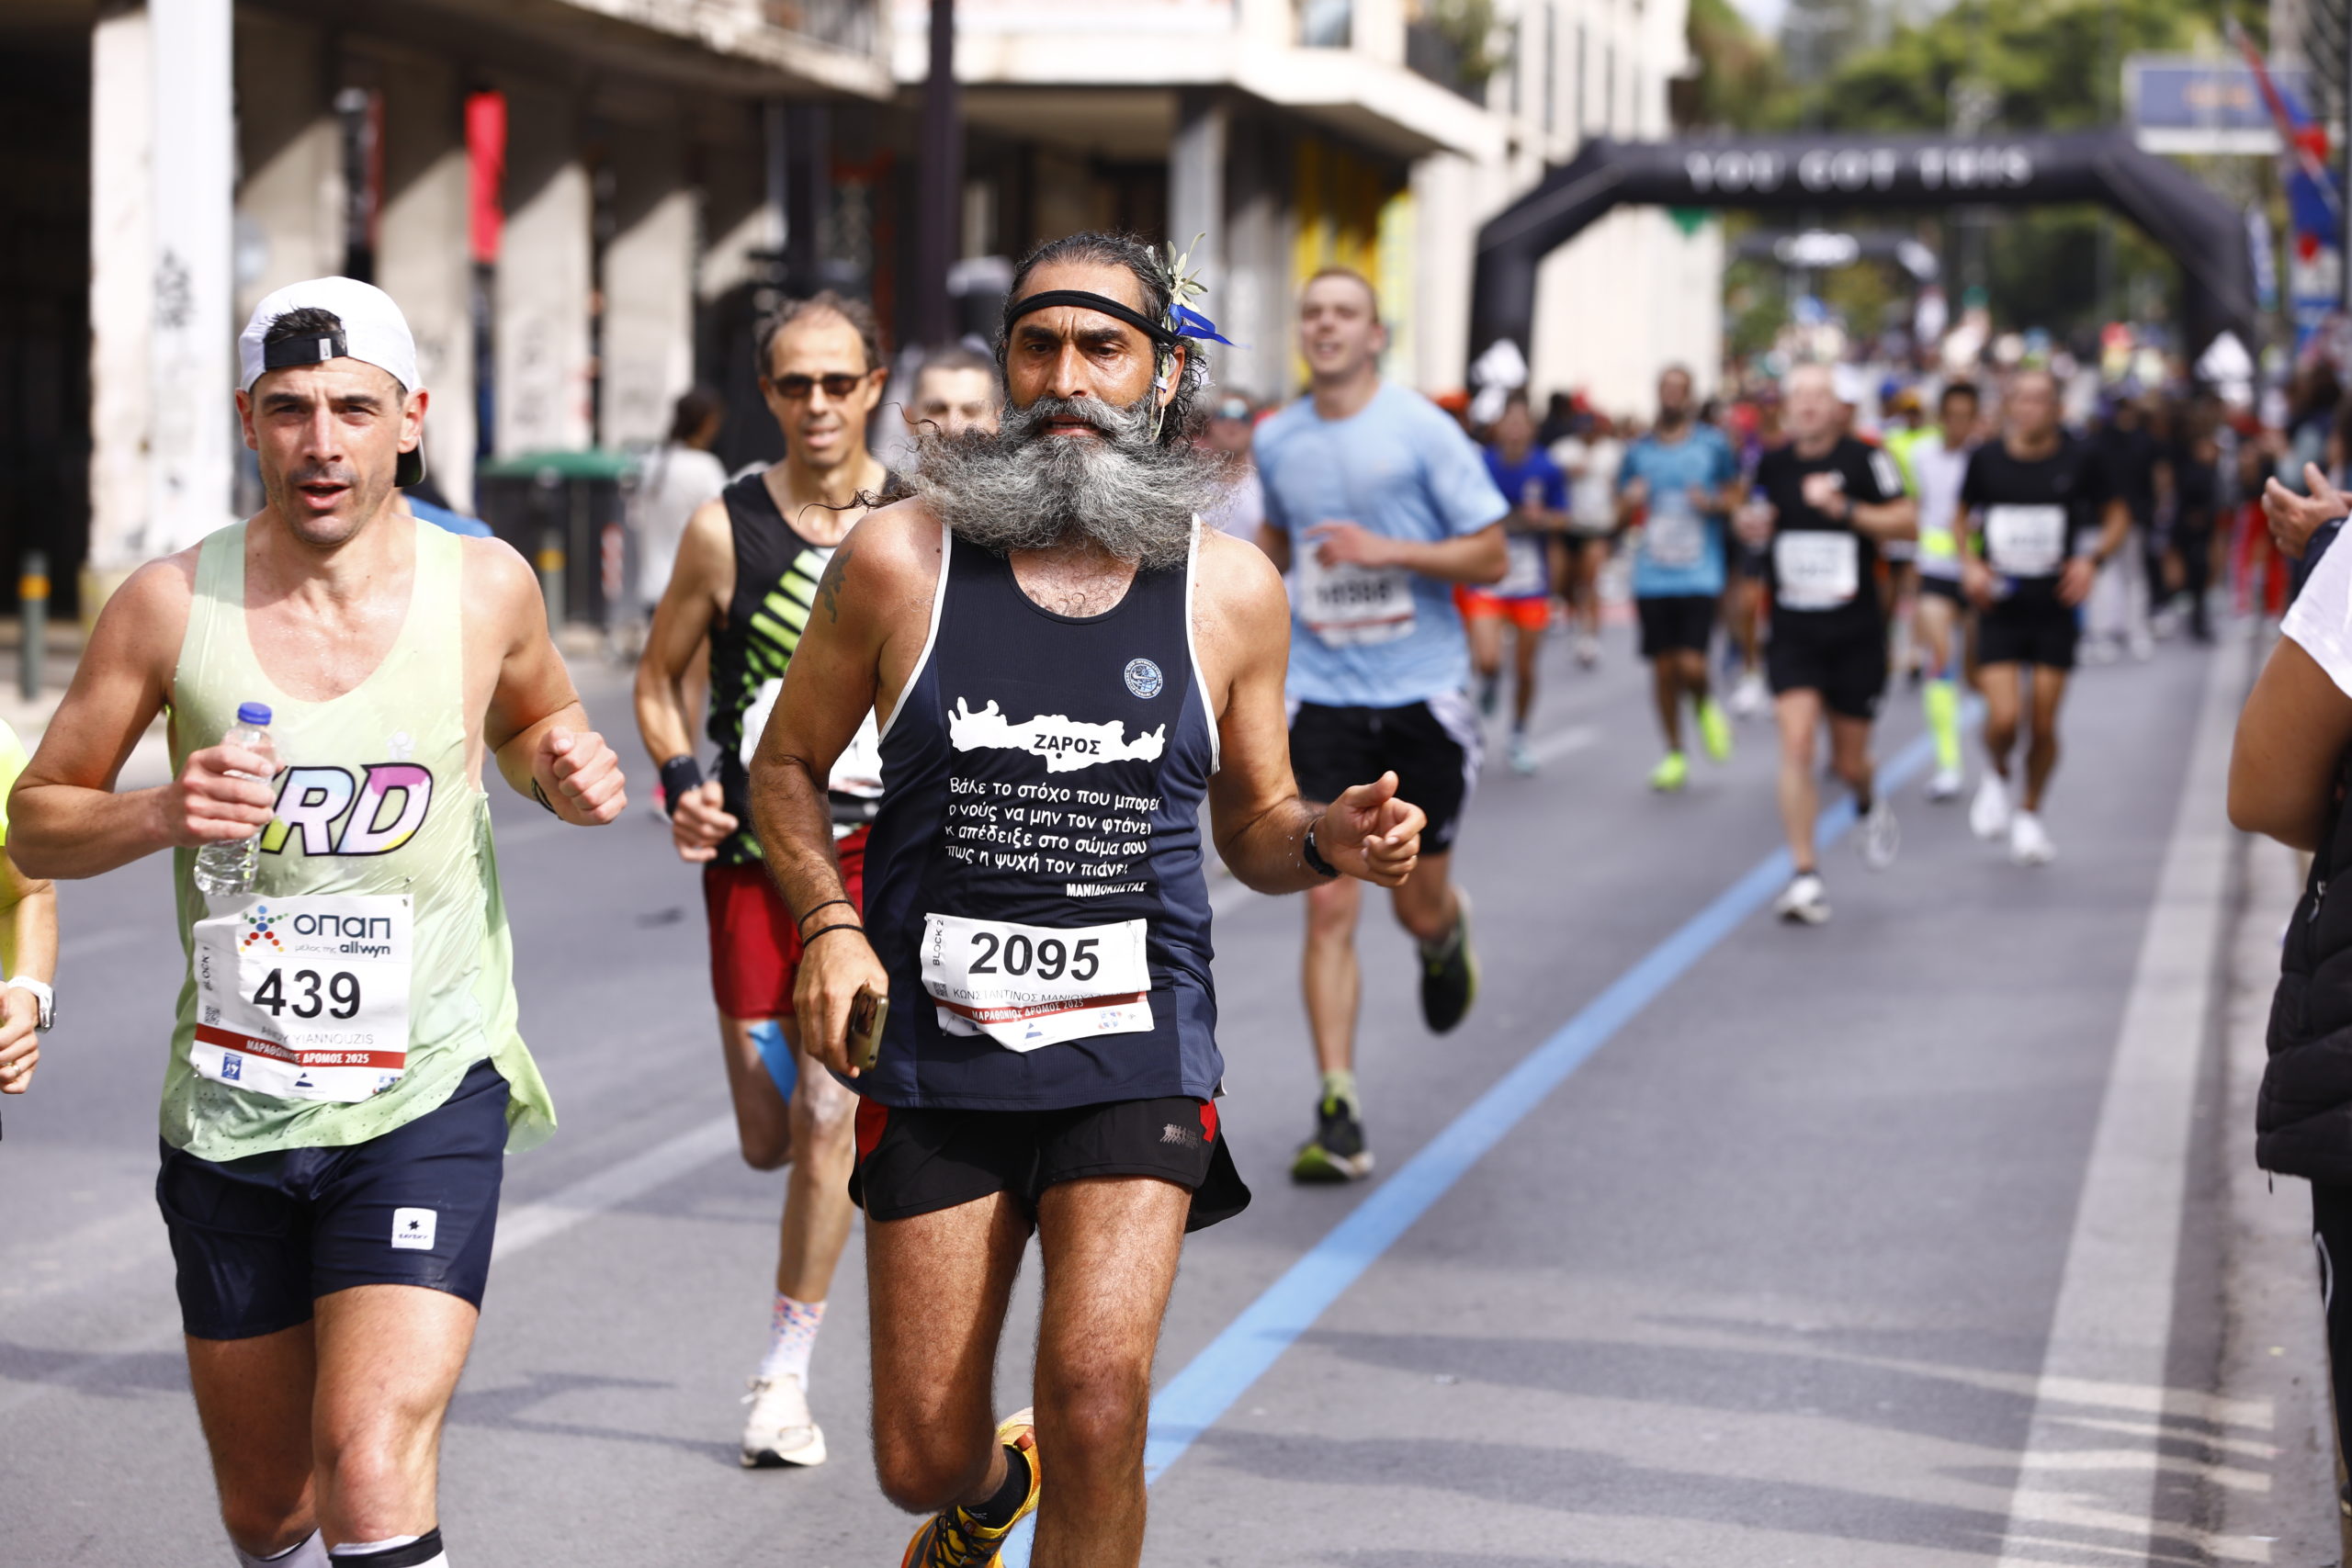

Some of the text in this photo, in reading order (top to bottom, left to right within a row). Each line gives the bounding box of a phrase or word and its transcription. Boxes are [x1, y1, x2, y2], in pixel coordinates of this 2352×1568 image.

[1034, 734, 1102, 755] ΖΑΡΟΣ
[260, 761, 433, 856] RD
[950, 777, 1163, 815] Βάλε το στόχο που μπορεί
[949, 800, 1152, 836] ο νούς να μην τον φτάνει
[959, 823, 1033, 850] απέδειξε
[1038, 834, 1069, 851] στο
[1076, 835, 1120, 858] σώμα
[1123, 840, 1148, 856] σου
[944, 845, 975, 864] πως
[979, 850, 989, 867] η
[995, 852, 1040, 874] ψυχή
[1046, 858, 1076, 874] τον
[339, 941, 390, 958] allwyn
[933, 919, 944, 966] BLOCK 2
[968, 931, 1100, 981] 2095
[253, 968, 360, 1020] 439
[971, 998, 1084, 1021] ΜΑΡΑΘΩΝΙΟΣ ΔΡΟΜΟΣ 2025
[302, 1053, 343, 1064] ΔΡΟΜΟΣ
[345, 1053, 370, 1065] 2025
